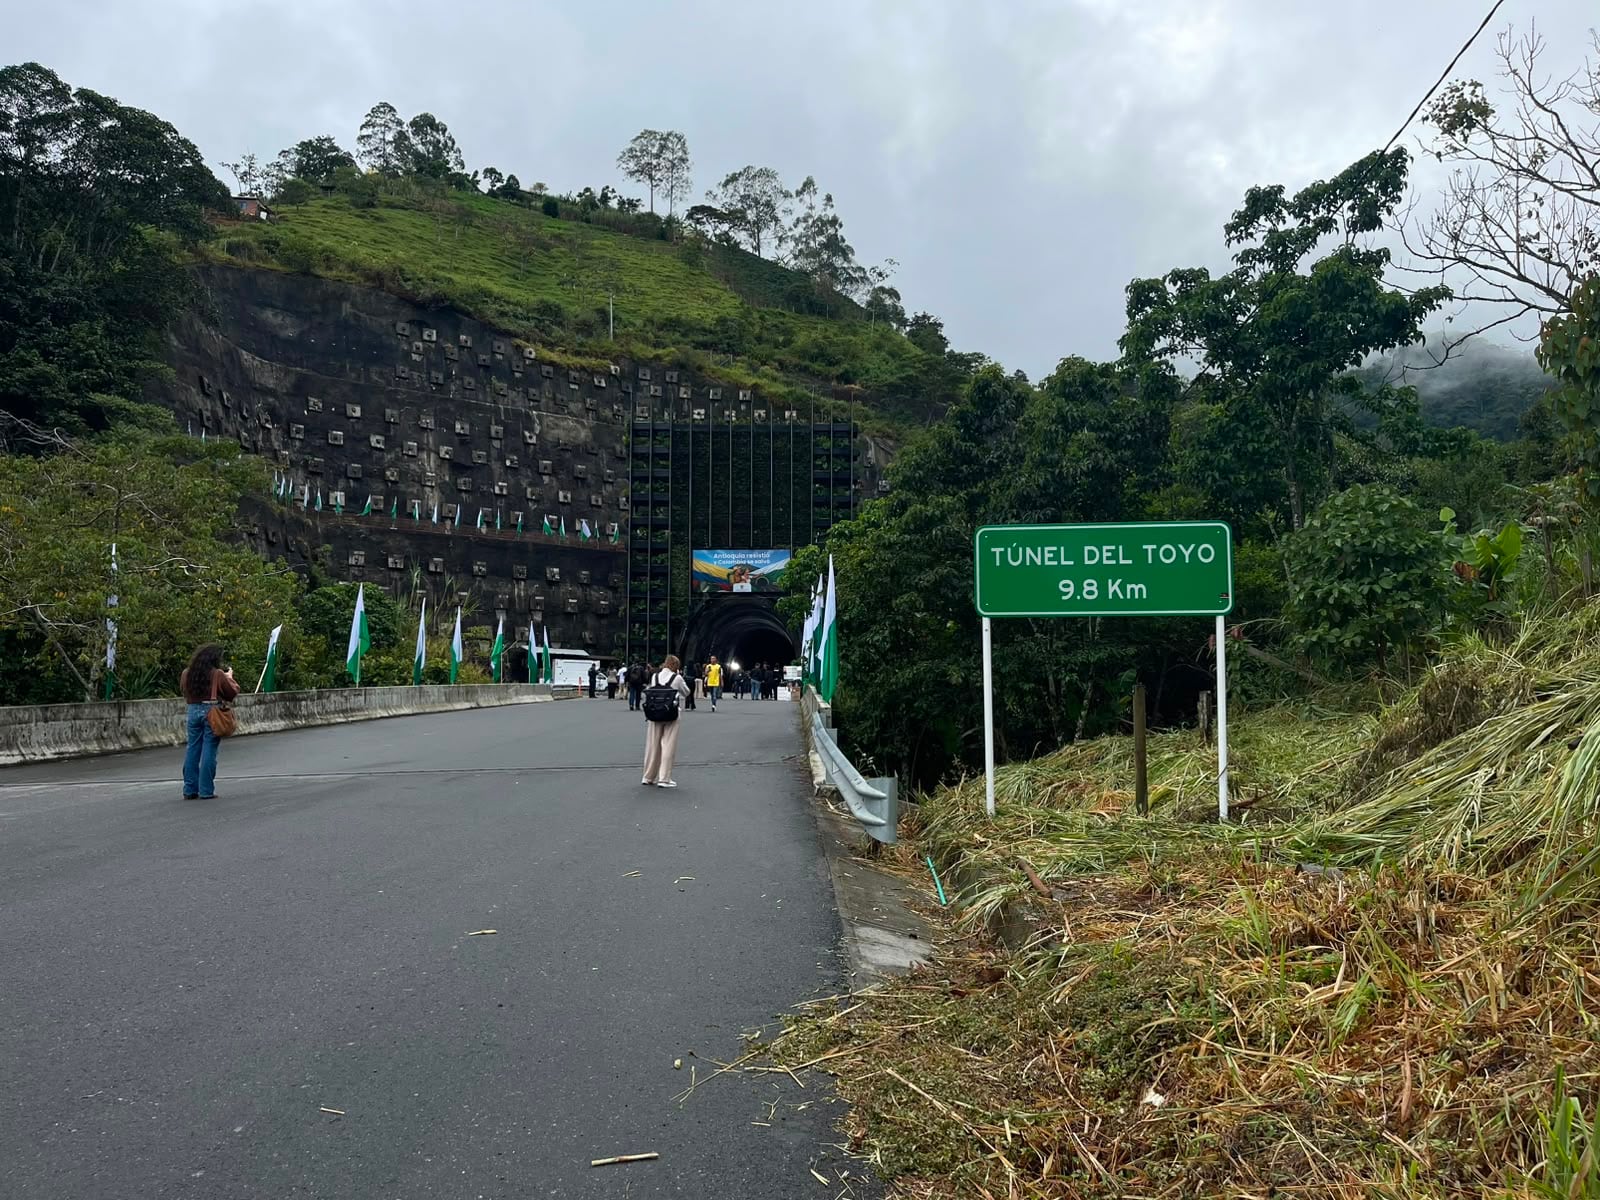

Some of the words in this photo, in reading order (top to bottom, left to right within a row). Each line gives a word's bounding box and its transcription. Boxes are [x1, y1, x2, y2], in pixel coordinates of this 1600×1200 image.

[991, 543, 1074, 566] TÚNEL
[1084, 545, 1133, 565] DEL
[1143, 543, 1216, 564] TOYO
[1058, 579, 1099, 600] 9.8
[1108, 578, 1147, 599] Km
